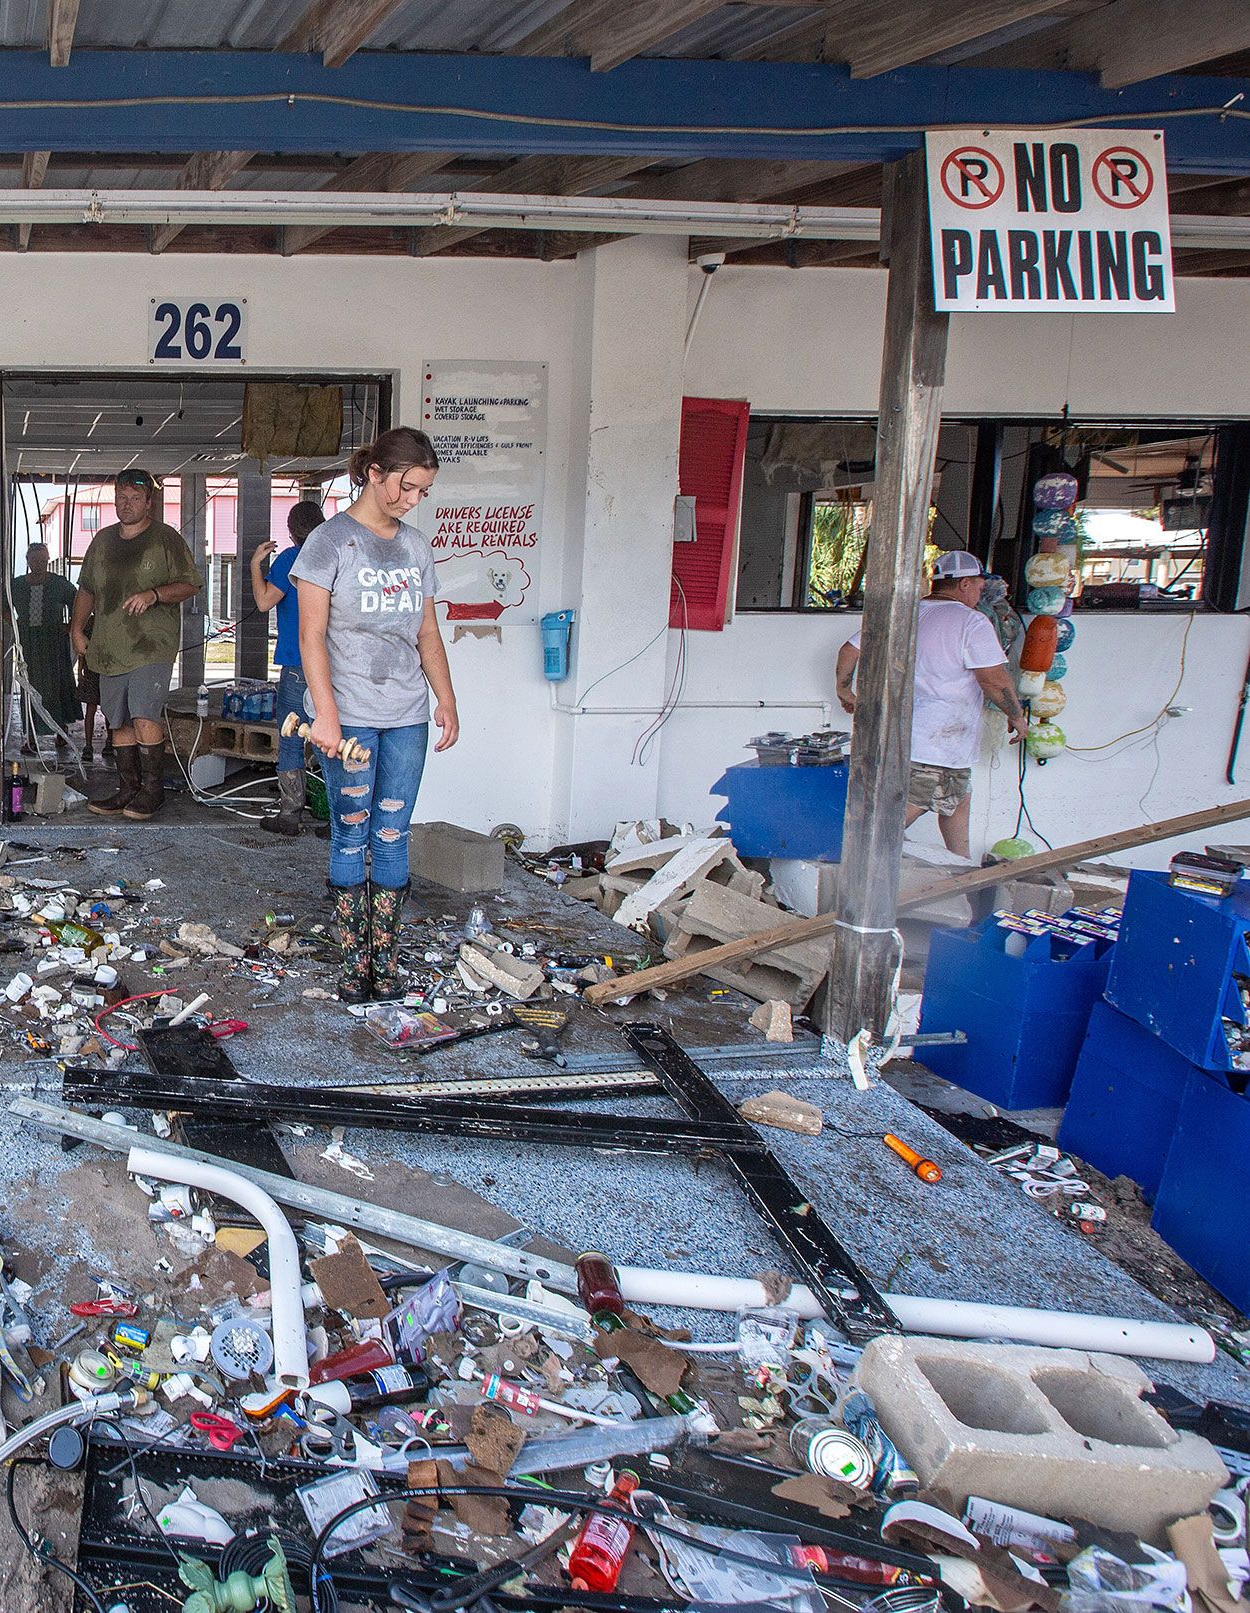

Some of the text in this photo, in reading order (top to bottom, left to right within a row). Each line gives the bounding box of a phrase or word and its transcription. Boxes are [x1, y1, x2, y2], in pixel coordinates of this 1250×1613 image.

[1014, 142, 1082, 213] NO
[941, 229, 1165, 301] PARKING
[154, 302, 242, 360] 262
[435, 397, 457, 405] KAYAK
[459, 397, 499, 406] LAUNCHING
[503, 398, 529, 406] PARKING
[435, 405, 477, 413] WET STORAGE
[434, 413, 486, 421] COVERED STORAGE
[437, 456, 461, 464] AYAKS
[435, 504, 535, 520] DRIVERS LICENSE
[438, 520, 526, 534] ARE REQUIRED
[430, 534, 449, 548] ON
[451, 534, 478, 548] ALL
[358, 567, 422, 587] GOD'S
[382, 579, 409, 597] NOT
[361, 590, 423, 613] DEAD
